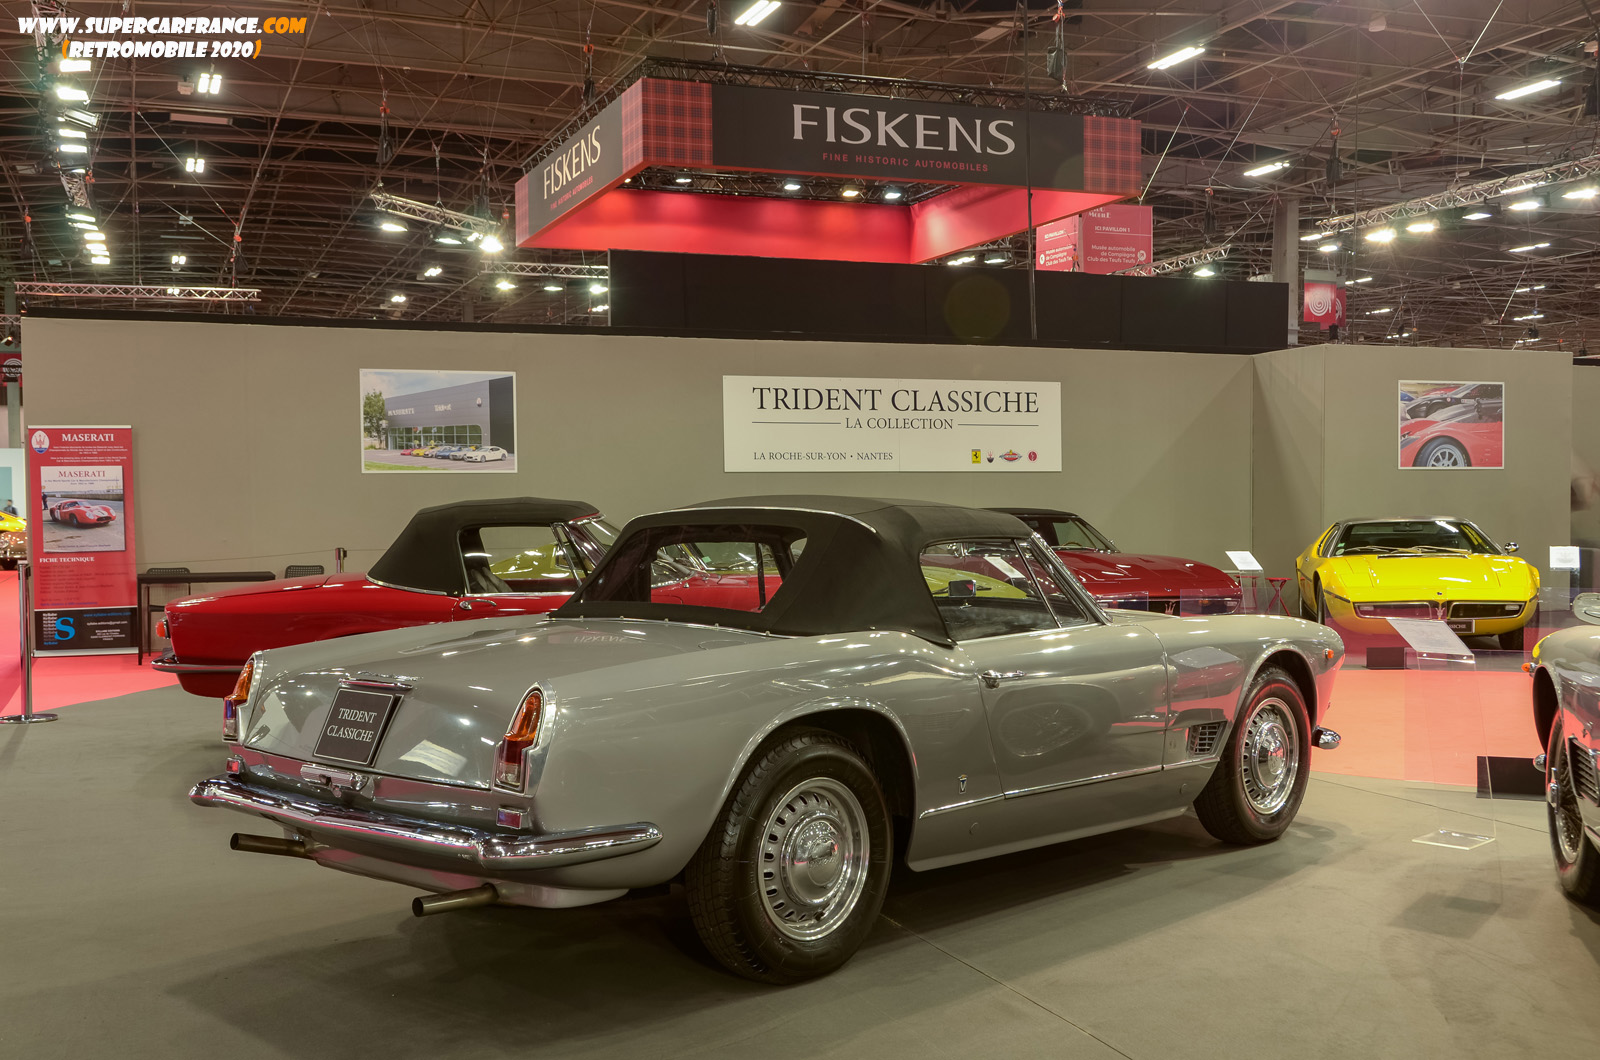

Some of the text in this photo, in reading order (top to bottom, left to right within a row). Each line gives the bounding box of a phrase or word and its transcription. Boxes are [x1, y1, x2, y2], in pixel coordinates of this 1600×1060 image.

[793, 103, 1016, 156] FISKENS
[544, 124, 601, 200] FISKENS
[823, 152, 988, 172] FINE HISTORIC AUTOMOBILES
[572, 176, 594, 196] AUTOMOBILES
[752, 386, 1039, 413] TRIDENT CLASSICHE
[846, 417, 954, 430] LA COLLECTION
[62, 433, 114, 442] MASERATI
[754, 452, 893, 461] LA ROCHE-SUR-YON NANTES
[58, 470, 106, 478] MASERATI
[338, 708, 377, 723] TRIDENT
[327, 725, 374, 742] CLASSICHE
